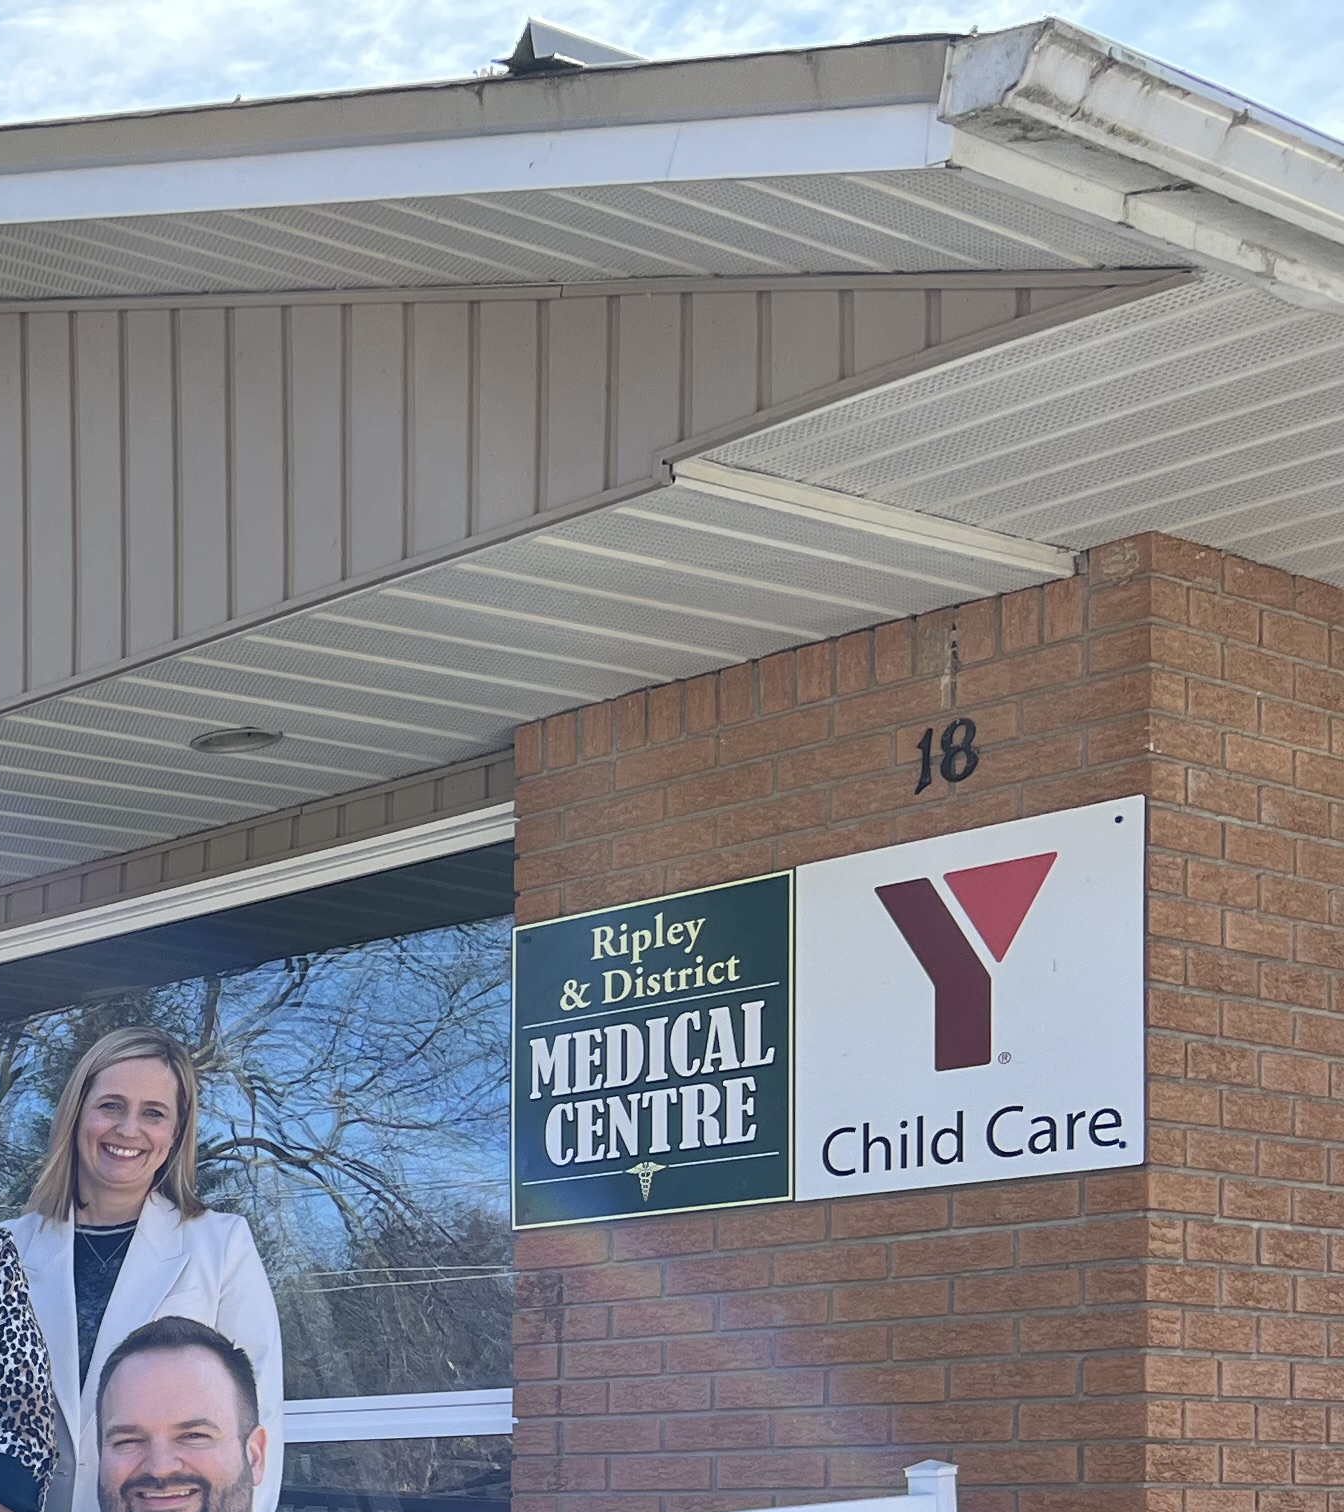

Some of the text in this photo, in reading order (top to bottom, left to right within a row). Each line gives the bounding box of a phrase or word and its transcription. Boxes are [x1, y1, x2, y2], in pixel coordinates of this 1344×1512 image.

[913, 717, 980, 796] 18
[590, 911, 707, 965] Ripley
[559, 955, 741, 1012] & District
[528, 1000, 776, 1100] MEDICAL
[544, 1076, 758, 1166] CENTRE
[821, 1104, 1123, 1178] Child Care
